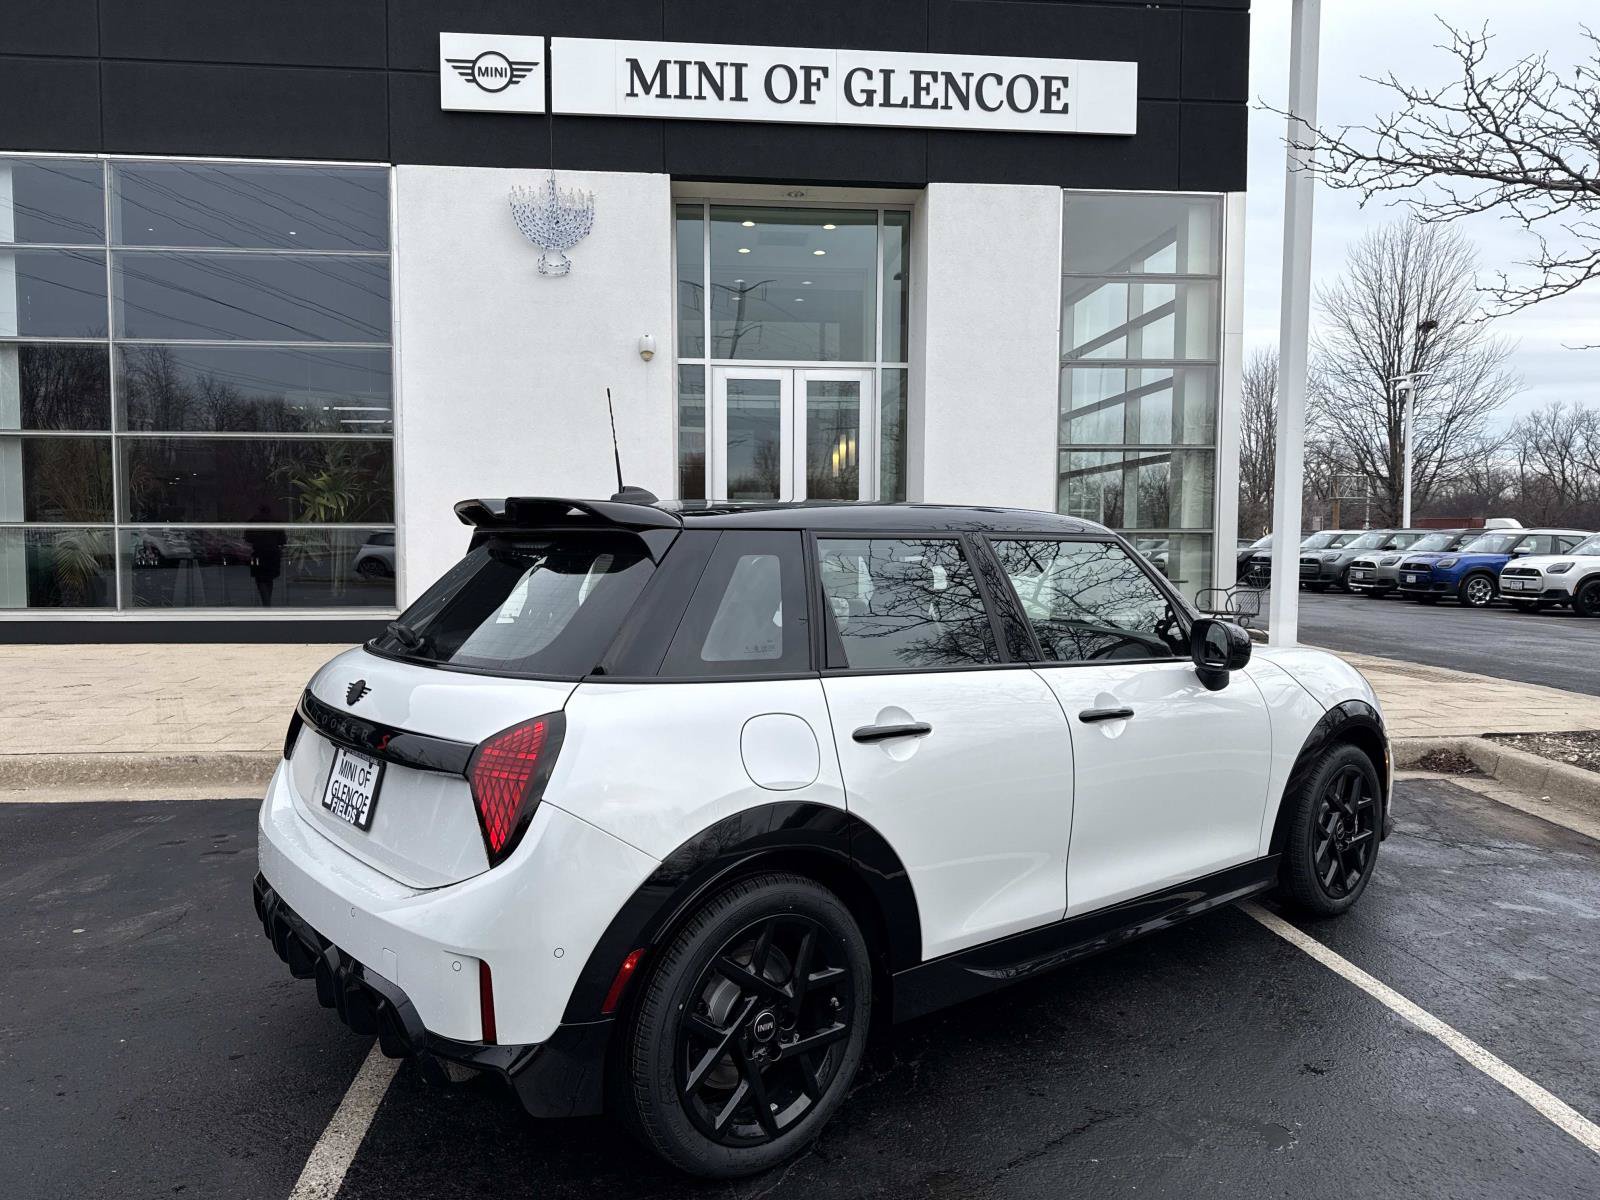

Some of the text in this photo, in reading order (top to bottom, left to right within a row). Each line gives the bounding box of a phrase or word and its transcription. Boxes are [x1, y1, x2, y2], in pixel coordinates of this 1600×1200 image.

[477, 66, 508, 78] MINI
[625, 57, 1070, 115] MINI OF GLENCOE
[339, 758, 371, 788] MINI OF
[331, 780, 369, 814] GLENCOE
[331, 797, 357, 824] FIELDS
